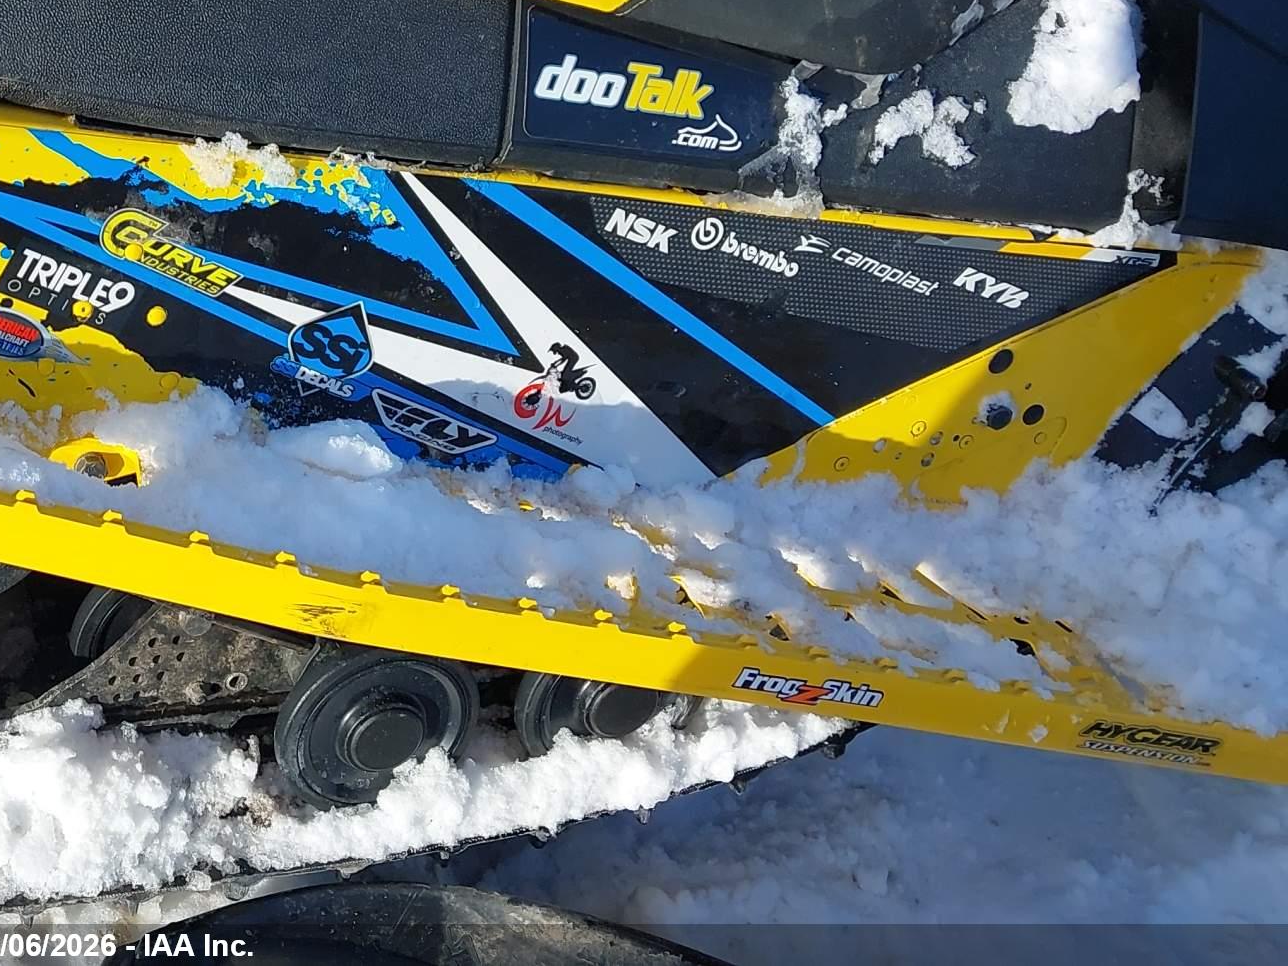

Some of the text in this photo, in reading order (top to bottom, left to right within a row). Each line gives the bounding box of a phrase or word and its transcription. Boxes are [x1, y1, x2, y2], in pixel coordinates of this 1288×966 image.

[534, 53, 714, 120] dooTalk
[671, 132, 719, 150] .com
[101, 209, 239, 289] CURVE
[604, 207, 680, 254] NSK
[140, 254, 222, 296] NDUSTRIES
[720, 231, 800, 278] brembo
[831, 246, 940, 297] camoplast
[1112, 255, 1158, 268] XRS
[16, 247, 136, 314] TRIPLE9
[952, 266, 1030, 309] KYB
[294, 366, 354, 398] DECALS
[378, 395, 494, 448] FLY
[542, 425, 585, 446] photography
[1080, 721, 1221, 753] HYGEAR
[1082, 740, 1200, 765] SUSPENSION
